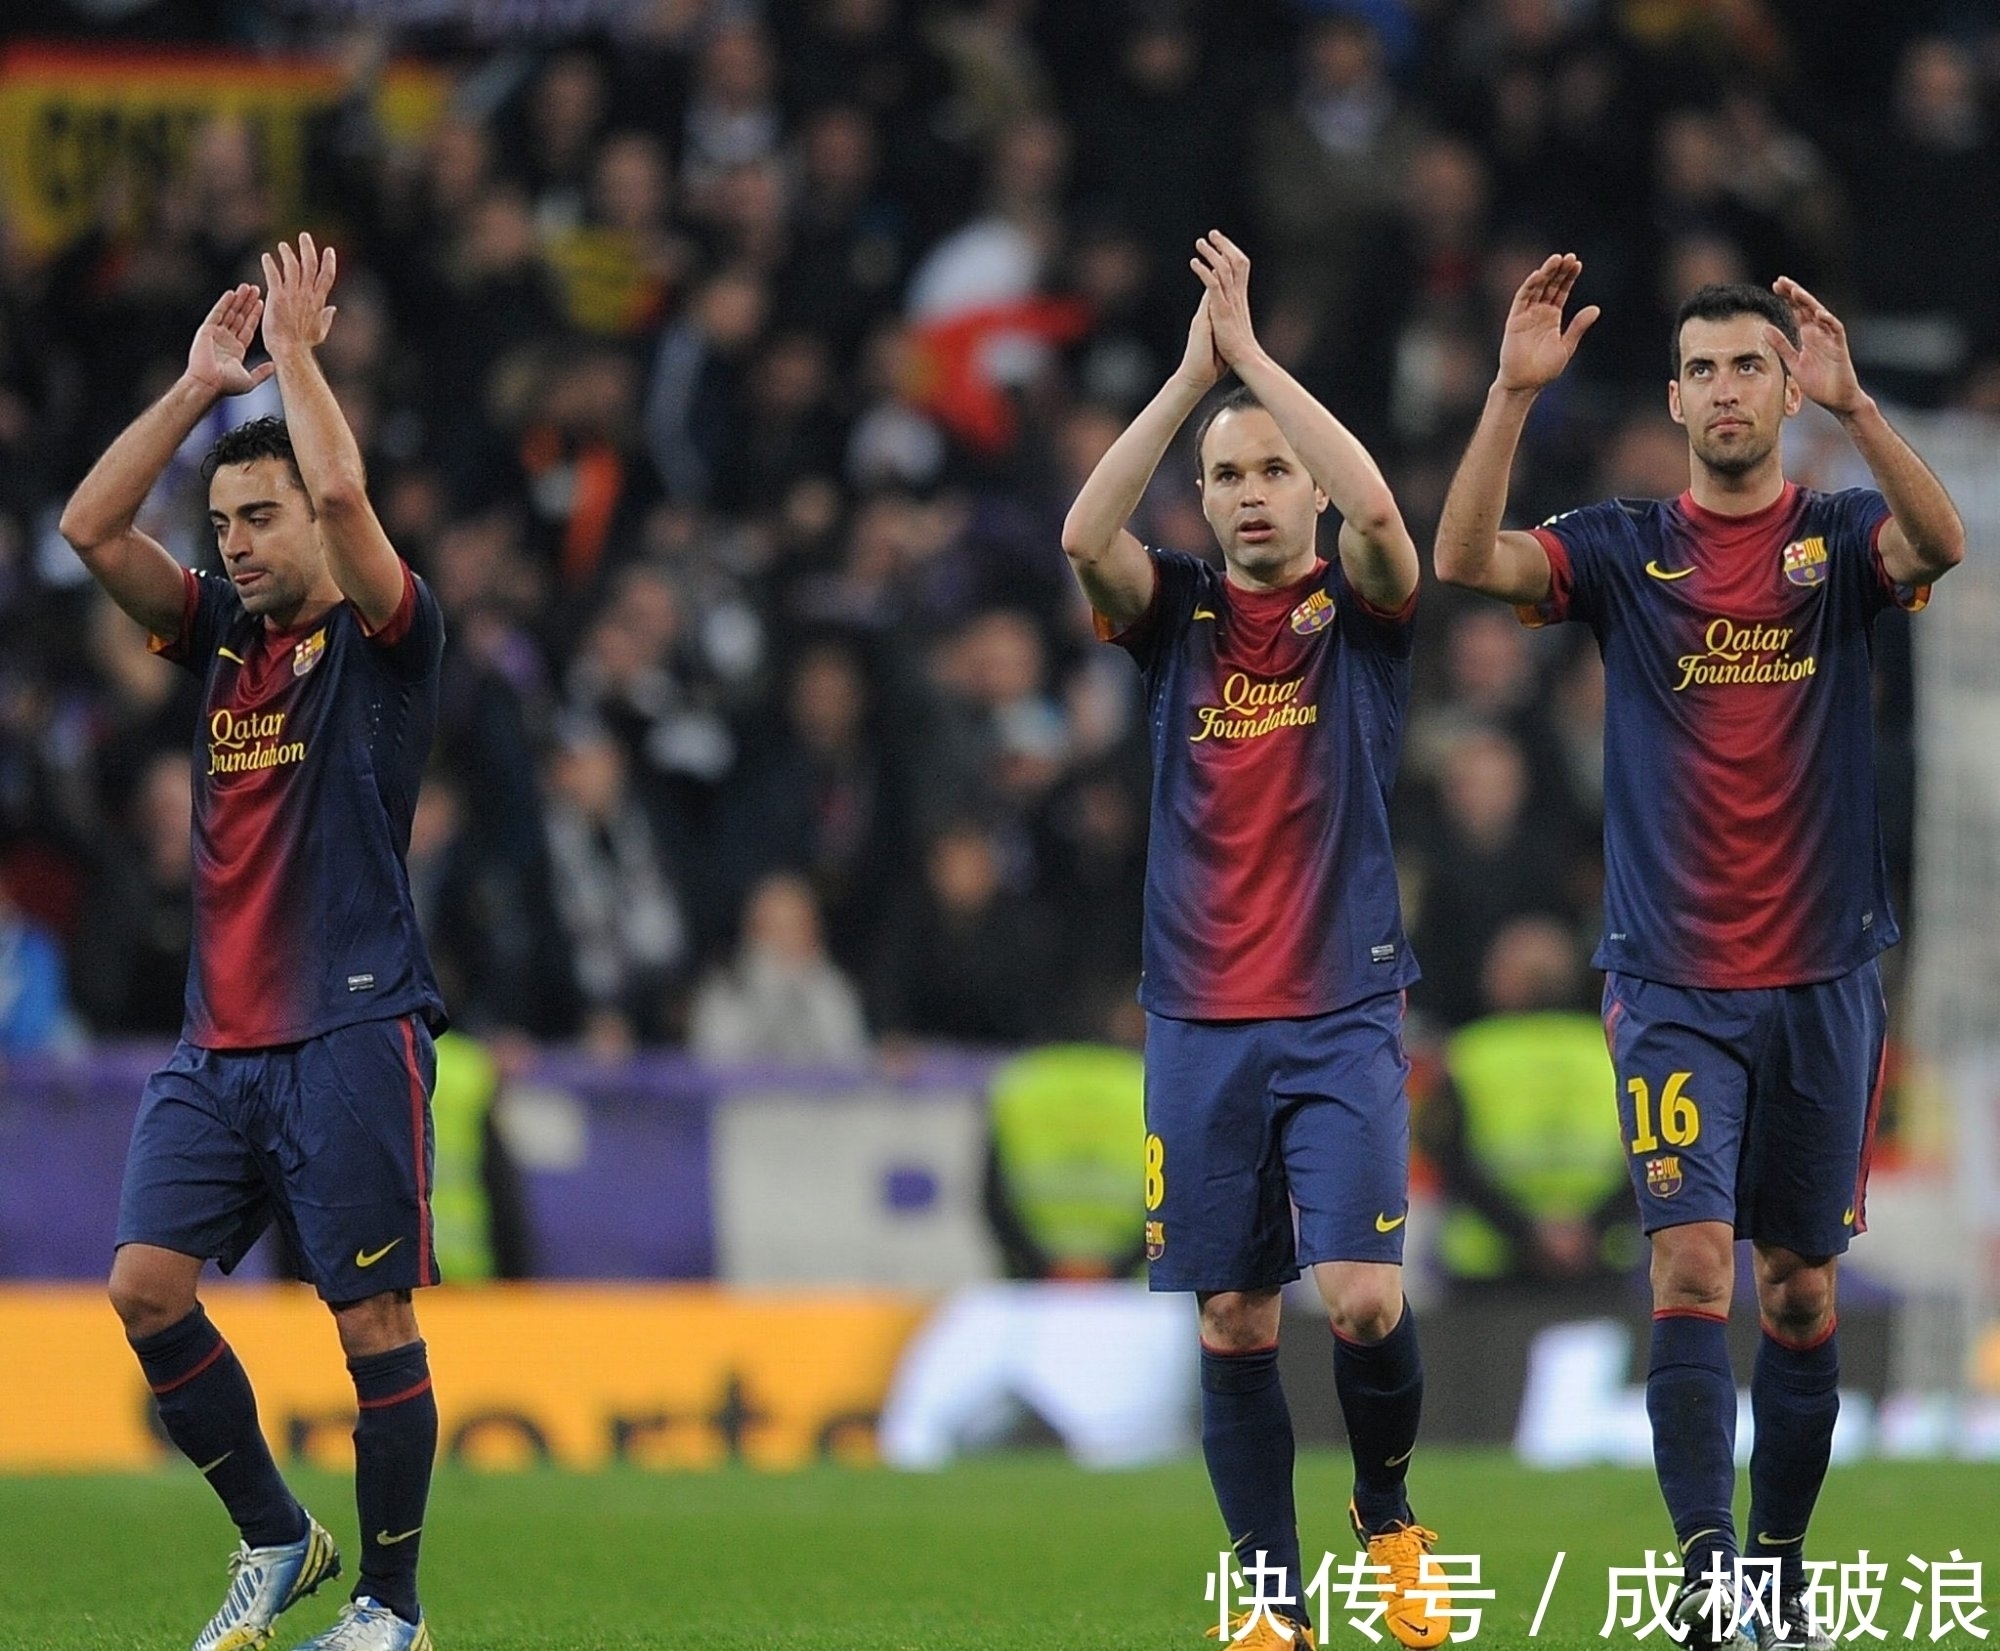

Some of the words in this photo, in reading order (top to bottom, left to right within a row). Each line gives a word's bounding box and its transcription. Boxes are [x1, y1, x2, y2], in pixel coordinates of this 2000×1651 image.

[1705, 618, 1794, 663] Qatar
[1223, 672, 1305, 717] Qatar
[1672, 653, 1817, 692] Foundation
[211, 709, 286, 750] Qatar
[1189, 697, 1318, 743] Foundation
[1627, 1072, 1700, 1155] 16
[1144, 1133, 1165, 1212] 8
